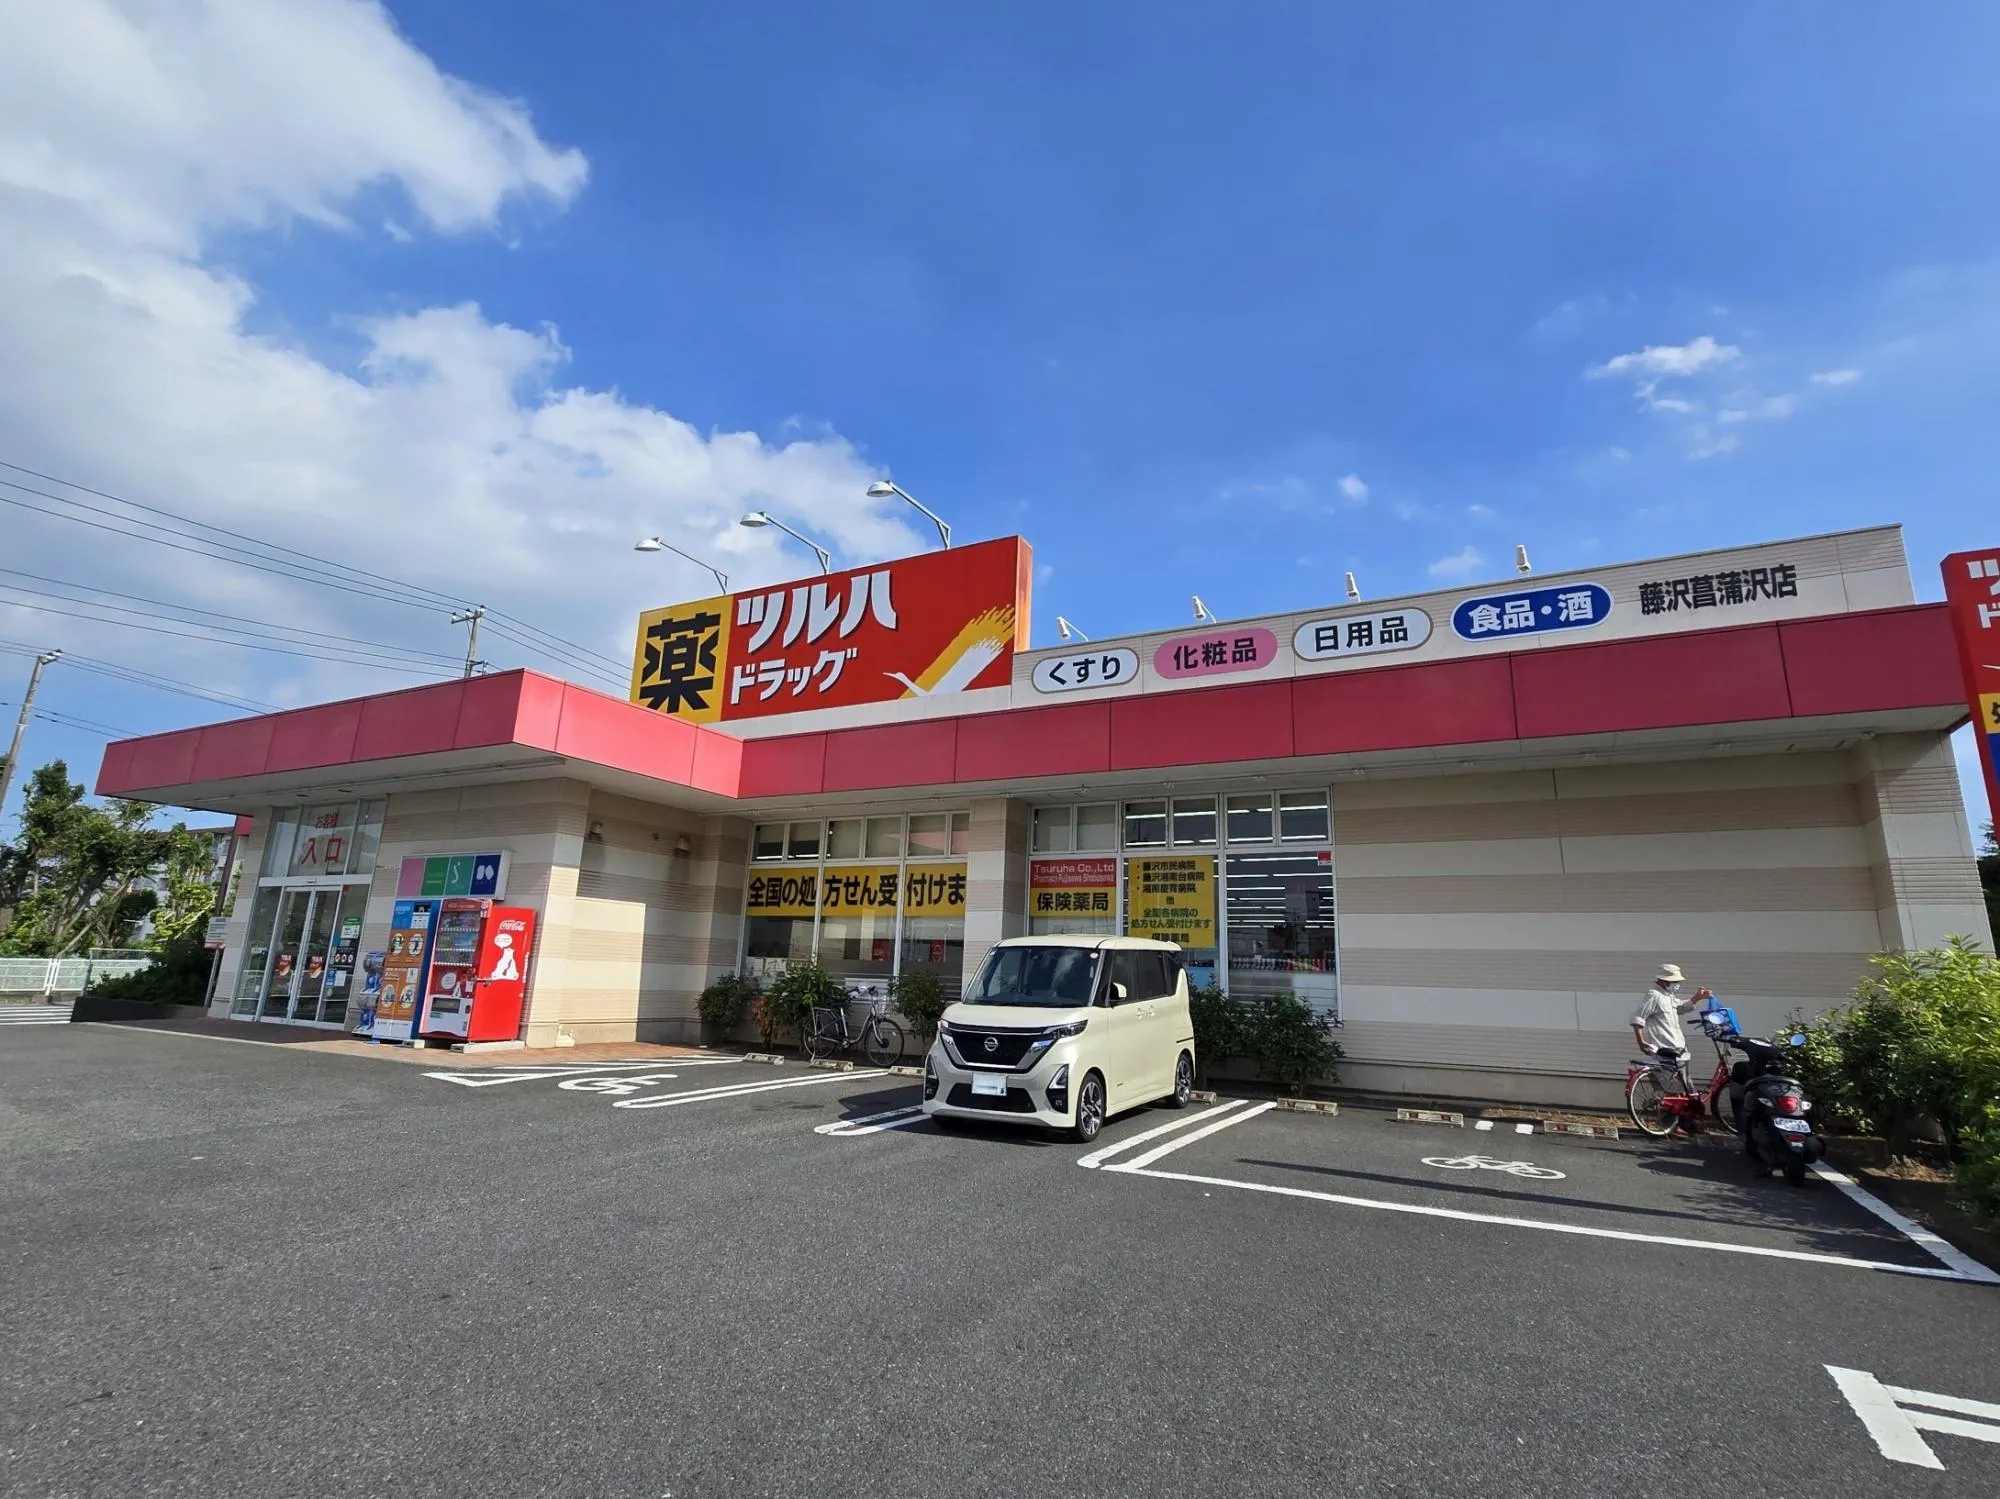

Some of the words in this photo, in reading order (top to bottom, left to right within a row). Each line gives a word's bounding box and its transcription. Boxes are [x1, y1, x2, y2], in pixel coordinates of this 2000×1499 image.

[1639, 564, 1798, 616] 藤沢菖蒲沢店
[737, 570, 897, 654] ツルハ
[1468, 590, 1594, 635] 食品・酒
[1314, 616, 1409, 653] 日用品
[639, 612, 720, 714] 薬
[1048, 655, 1121, 686] くすり
[1172, 636, 1258, 671] 化粧品
[731, 647, 858, 705] ドラッグ
[1033, 864, 1075, 874] Tsuruha
[1037, 892, 1109, 911] 保険薬局
[1131, 918, 1212, 929] 処方せん受付けます
